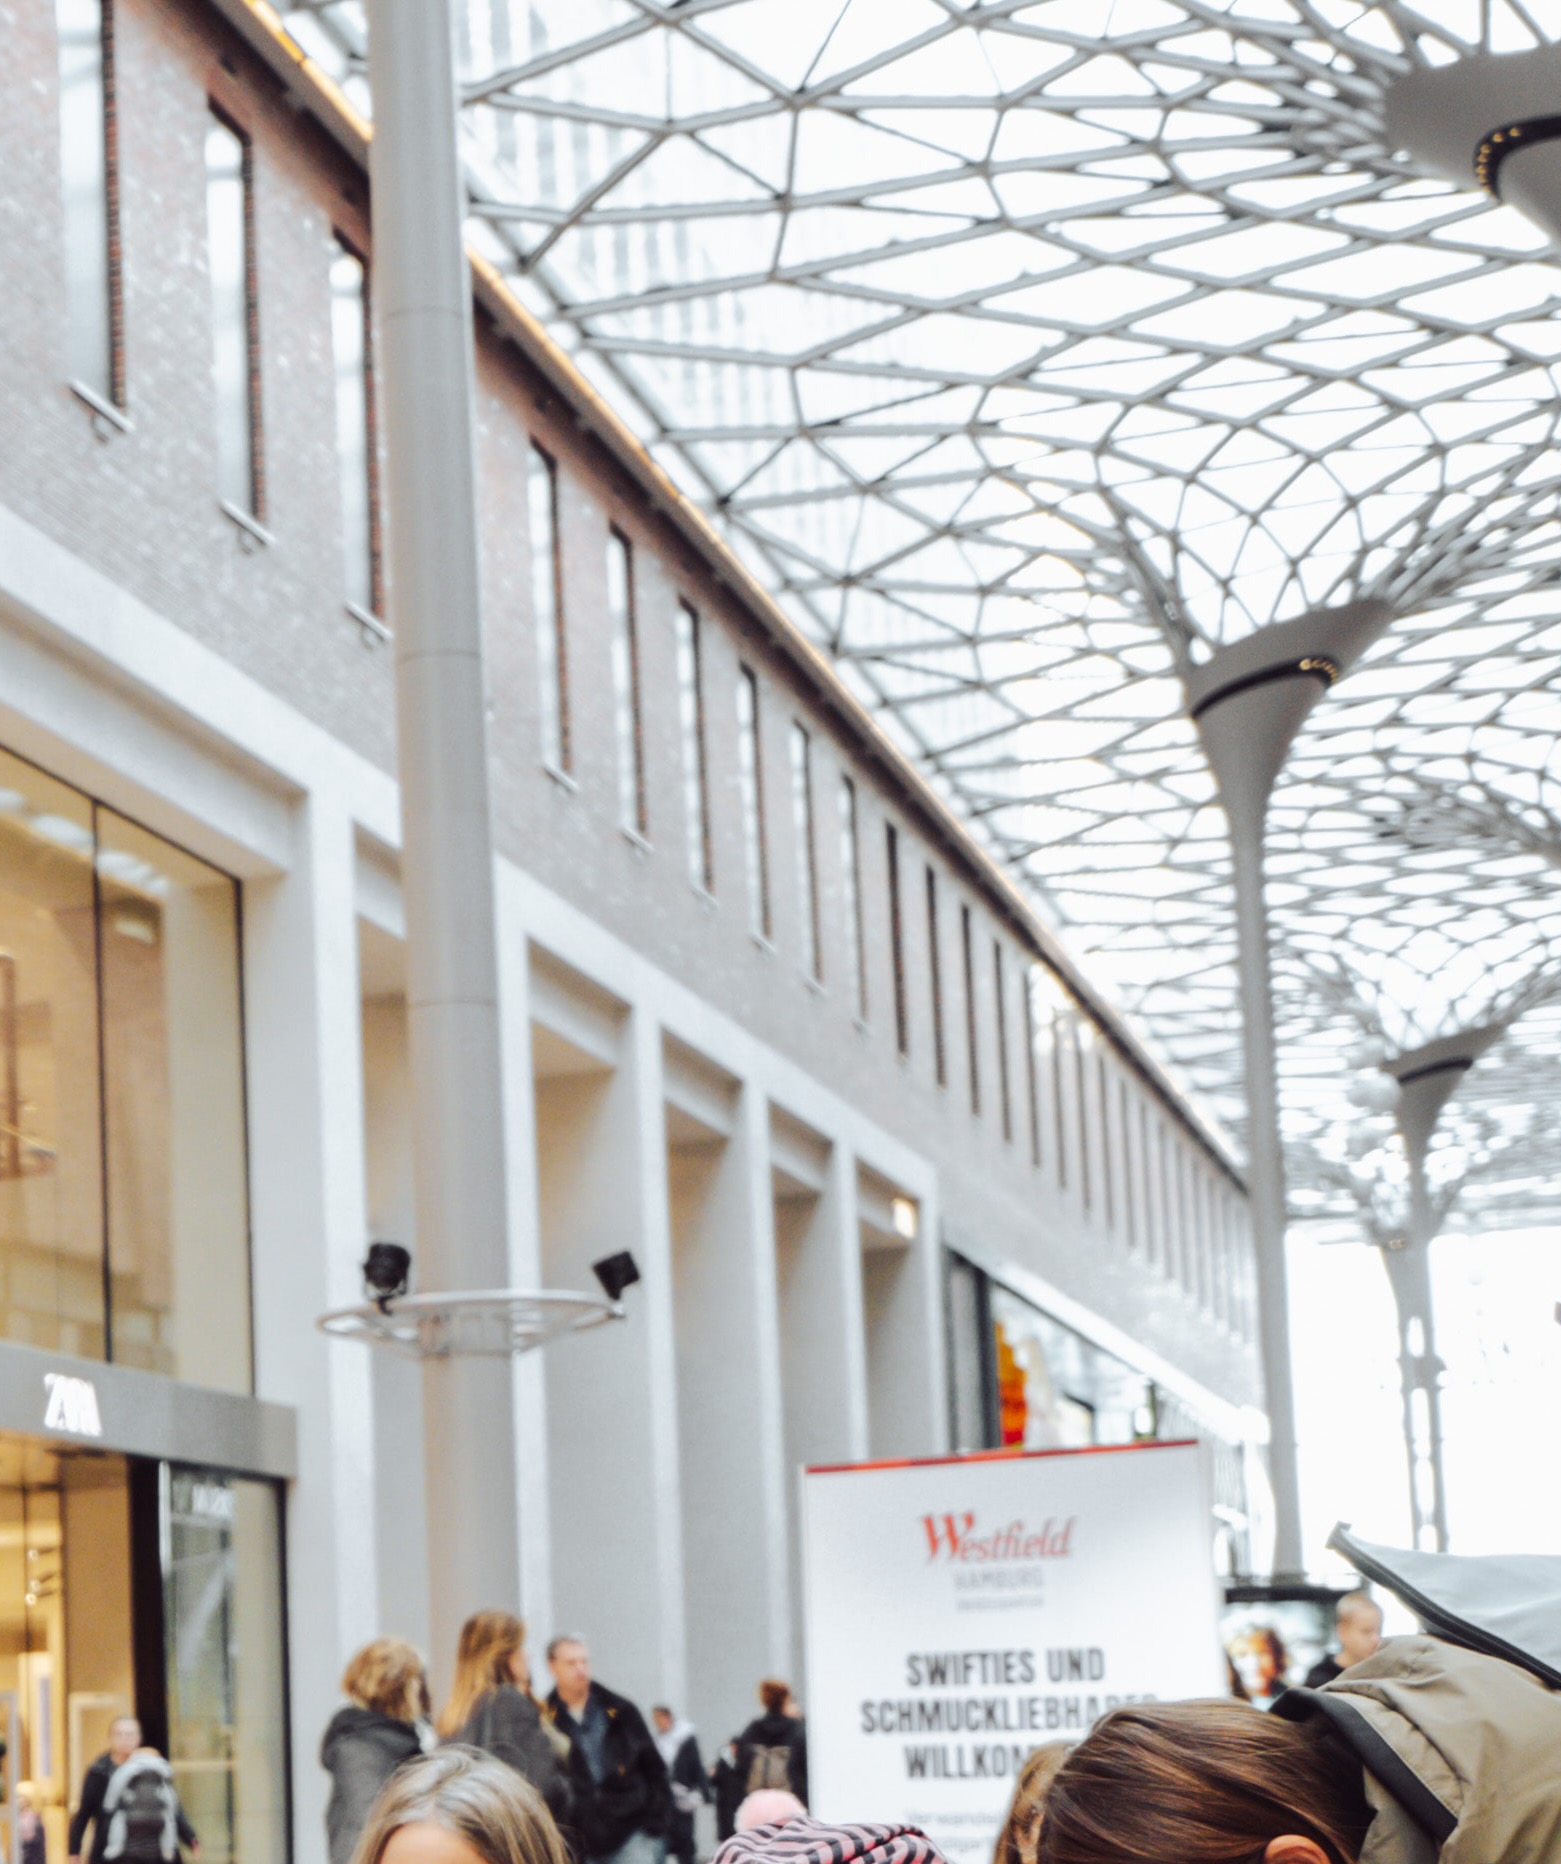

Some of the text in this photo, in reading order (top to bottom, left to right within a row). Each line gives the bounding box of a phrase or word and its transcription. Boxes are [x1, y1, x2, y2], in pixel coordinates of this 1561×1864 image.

[920, 1509, 1077, 1562] Westfield
[905, 1646, 1106, 1687] SWIFTIES UND
